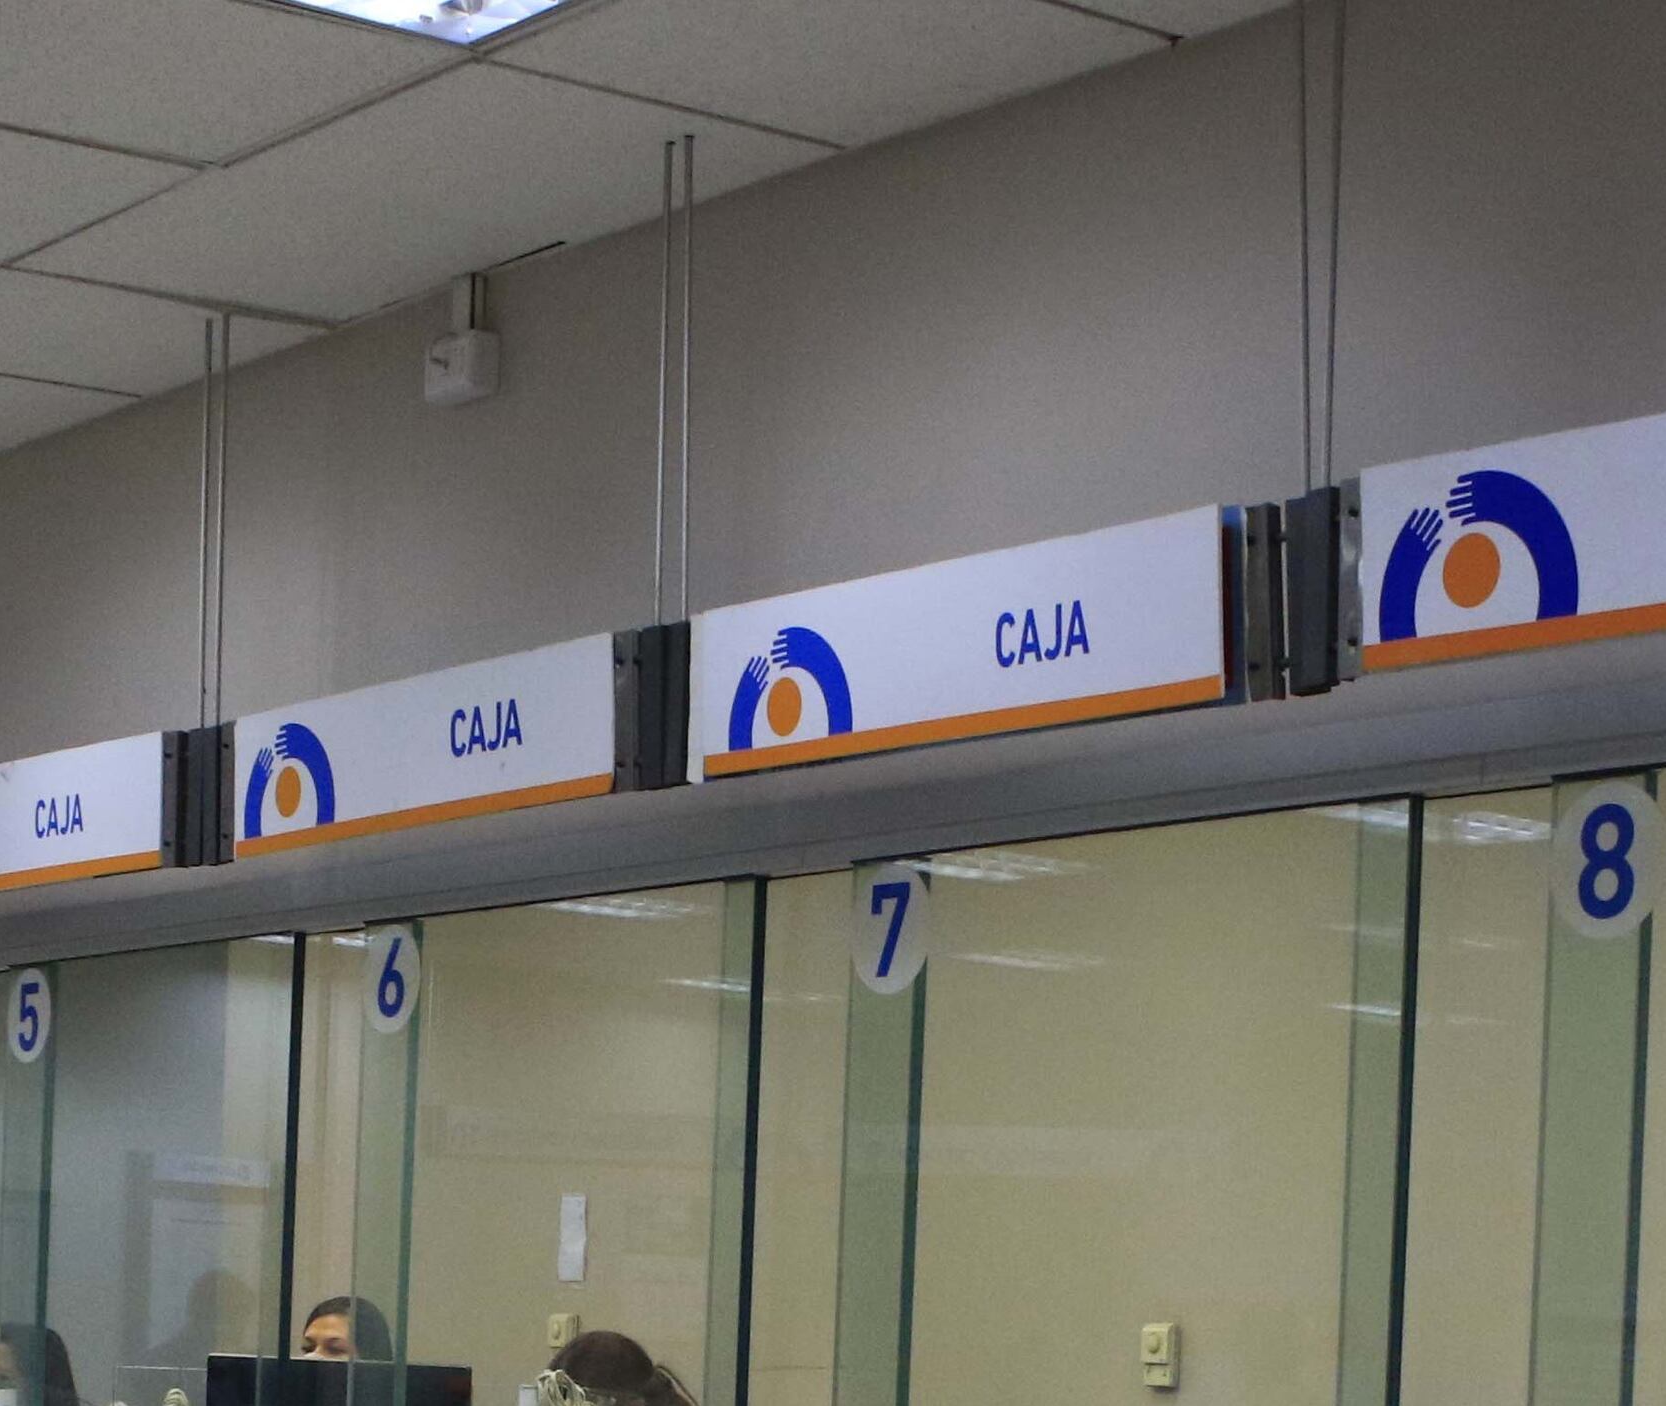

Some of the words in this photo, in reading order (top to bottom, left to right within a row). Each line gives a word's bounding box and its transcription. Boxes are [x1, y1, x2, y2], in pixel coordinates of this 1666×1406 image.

[995, 600, 1090, 667] CAJA
[450, 698, 523, 757] CAJA
[35, 793, 83, 838] CAJA
[1578, 803, 1636, 920] 8
[871, 882, 911, 978] 7
[376, 937, 406, 1018] 6
[17, 982, 41, 1053] 5
